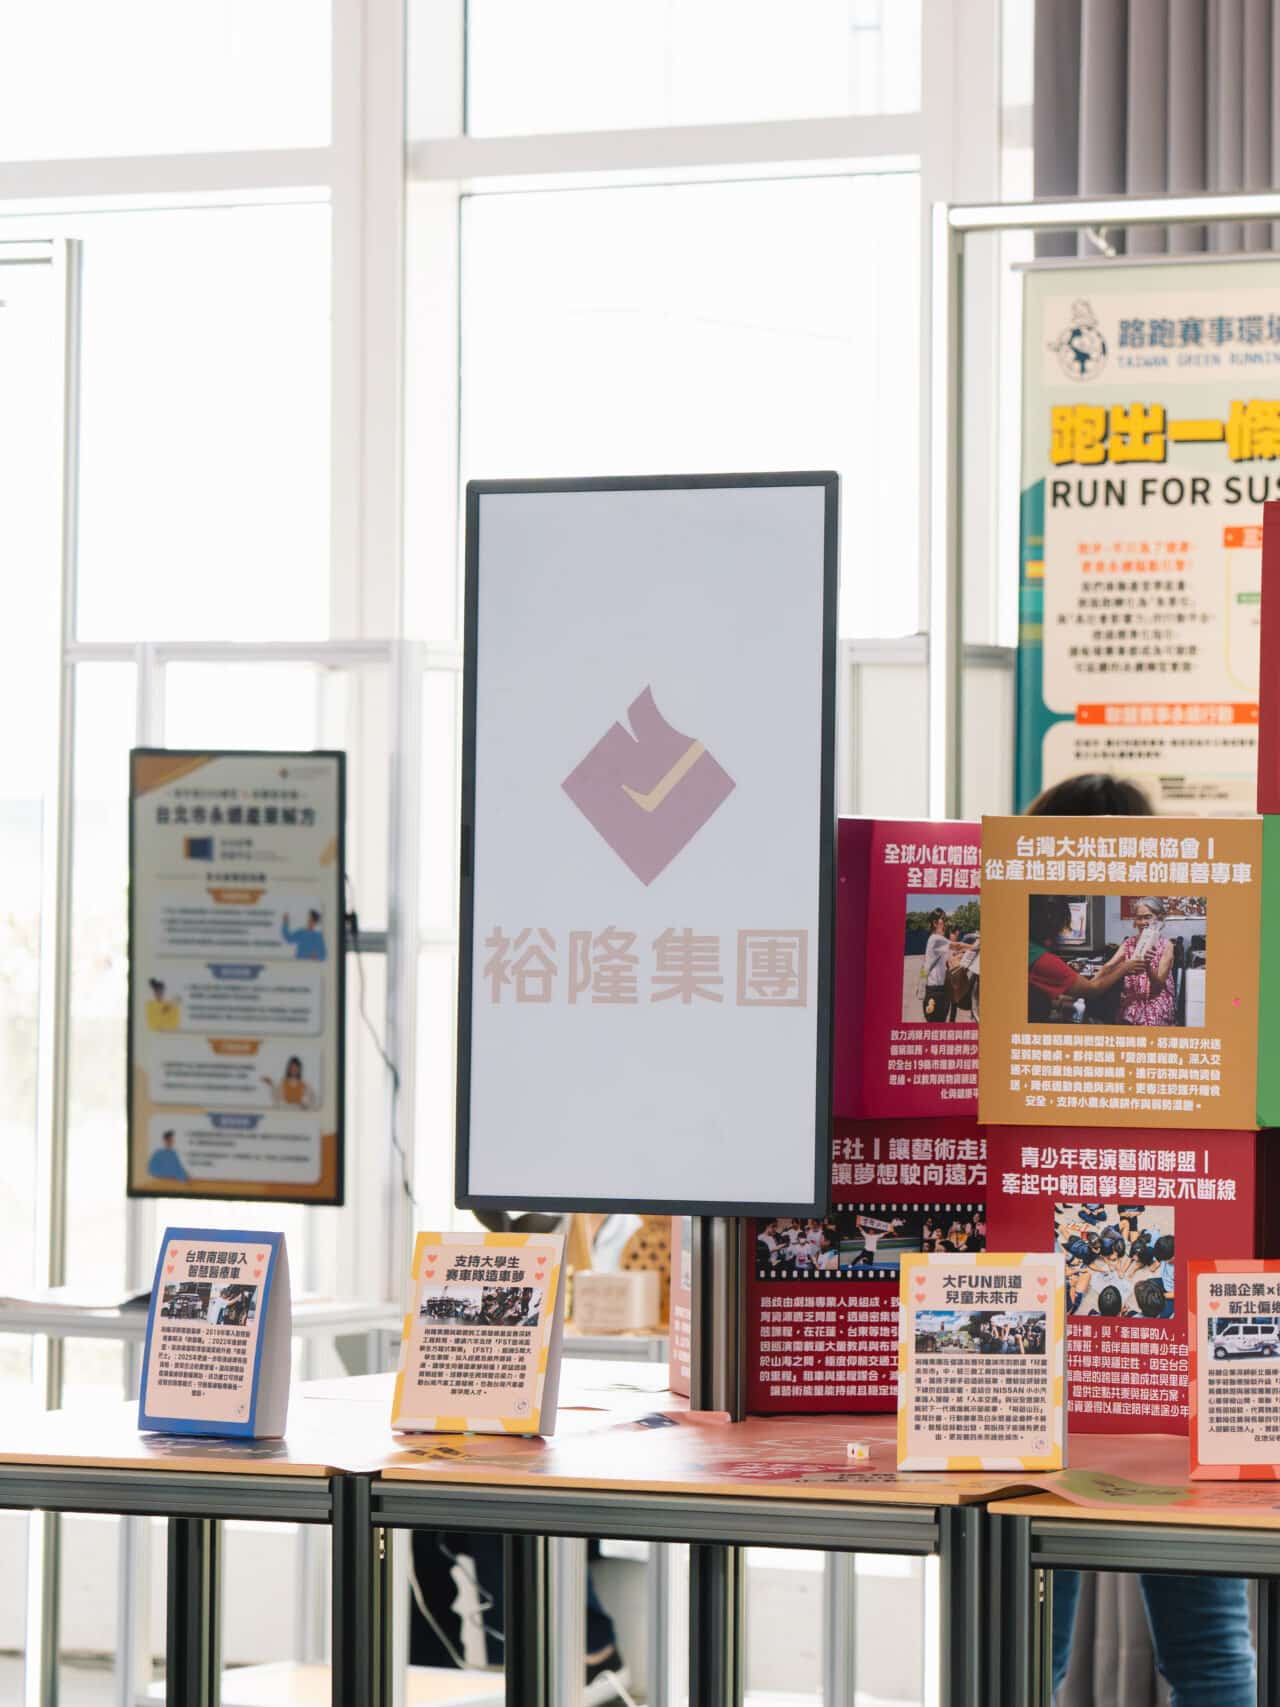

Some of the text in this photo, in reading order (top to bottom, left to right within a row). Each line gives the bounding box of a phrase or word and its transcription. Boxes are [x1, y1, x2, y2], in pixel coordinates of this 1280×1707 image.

[1052, 478, 1126, 508] RUN
[1141, 476, 1210, 506] FOR
[884, 844, 982, 866] 全球小紅帽協
[483, 925, 809, 1008] 裕隆集團
[832, 1163, 987, 1186] 讓夢想駛向遠方
[1002, 1173, 1236, 1201] 牽起中輟風箏學習永不斷線
[454, 1255, 520, 1269] 支持大學生
[446, 1269, 525, 1283] 賽車隊造車夢
[942, 1275, 1022, 1289] 大FUN凱道
[946, 1291, 1018, 1305] 兒童未來市
